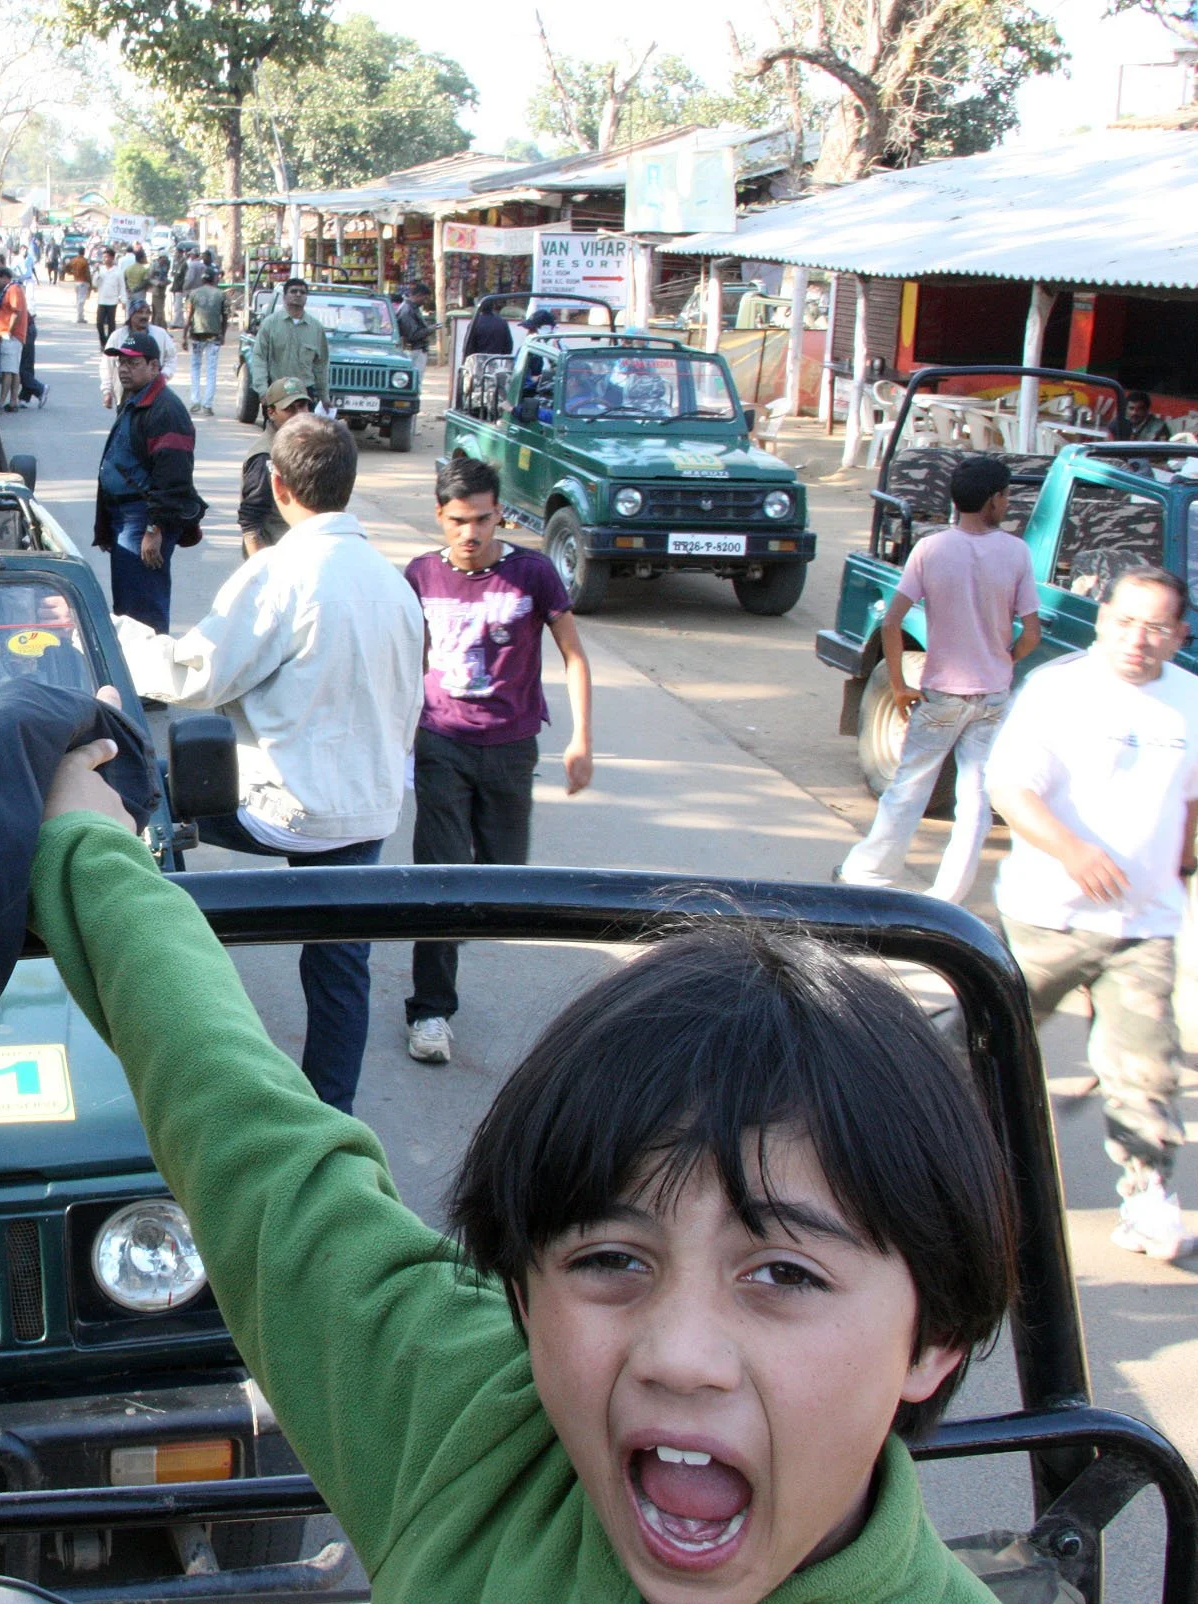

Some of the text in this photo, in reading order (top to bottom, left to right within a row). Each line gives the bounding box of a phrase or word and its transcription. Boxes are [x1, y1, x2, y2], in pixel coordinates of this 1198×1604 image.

[541, 240, 569, 256] VAN
[581, 241, 626, 256] VIHAR
[542, 260, 622, 268] RESORT
[681, 470, 730, 478] MARUTI
